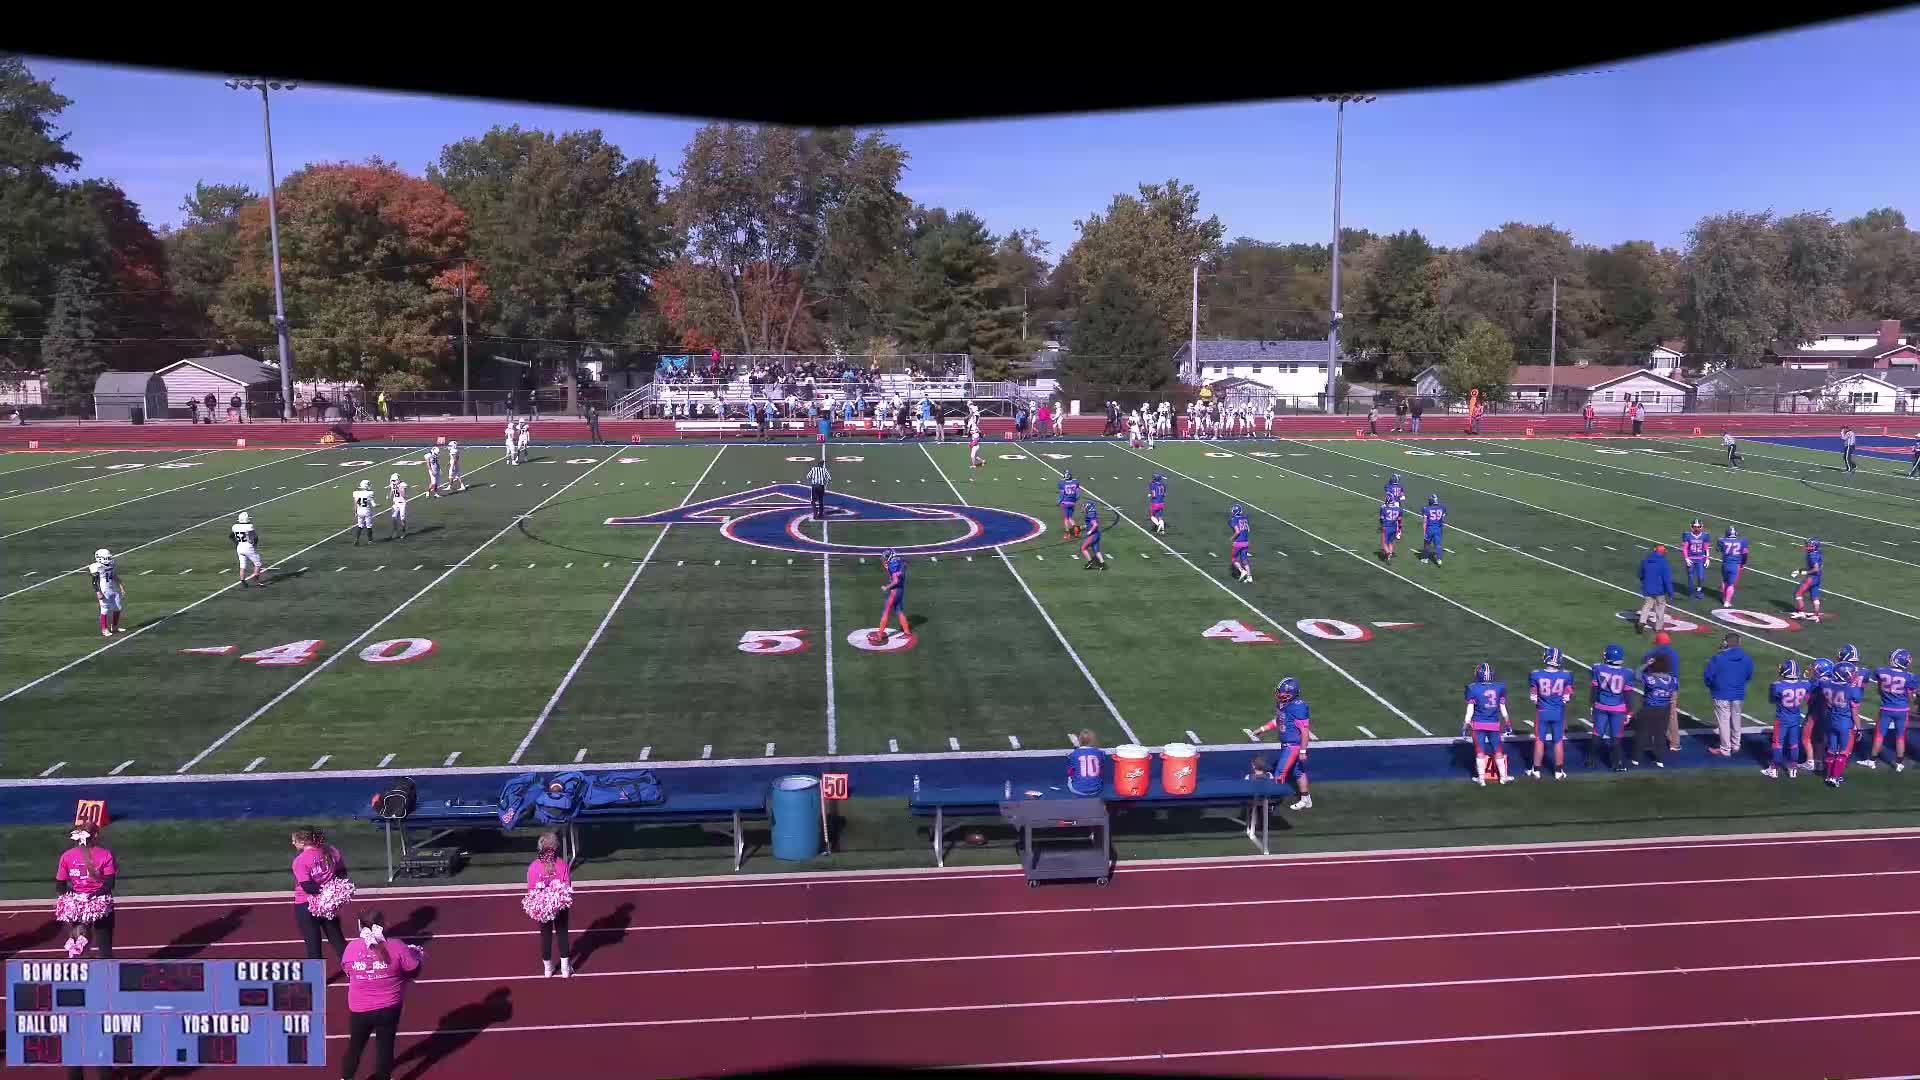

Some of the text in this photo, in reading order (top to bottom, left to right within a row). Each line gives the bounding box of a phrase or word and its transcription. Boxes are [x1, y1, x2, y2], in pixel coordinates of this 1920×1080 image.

[355, 497, 368, 508] 45
[1429, 509, 1443, 521] 59
[1724, 542, 1742, 555] 72
[1538, 677, 1565, 697] 84
[1599, 672, 1625, 694] 70
[1879, 673, 1906, 695] 22
[1483, 689, 1498, 709] 3
[1078, 754, 1100, 778] 10
[824, 776, 847, 799] 50
[77, 803, 102, 827] 40
